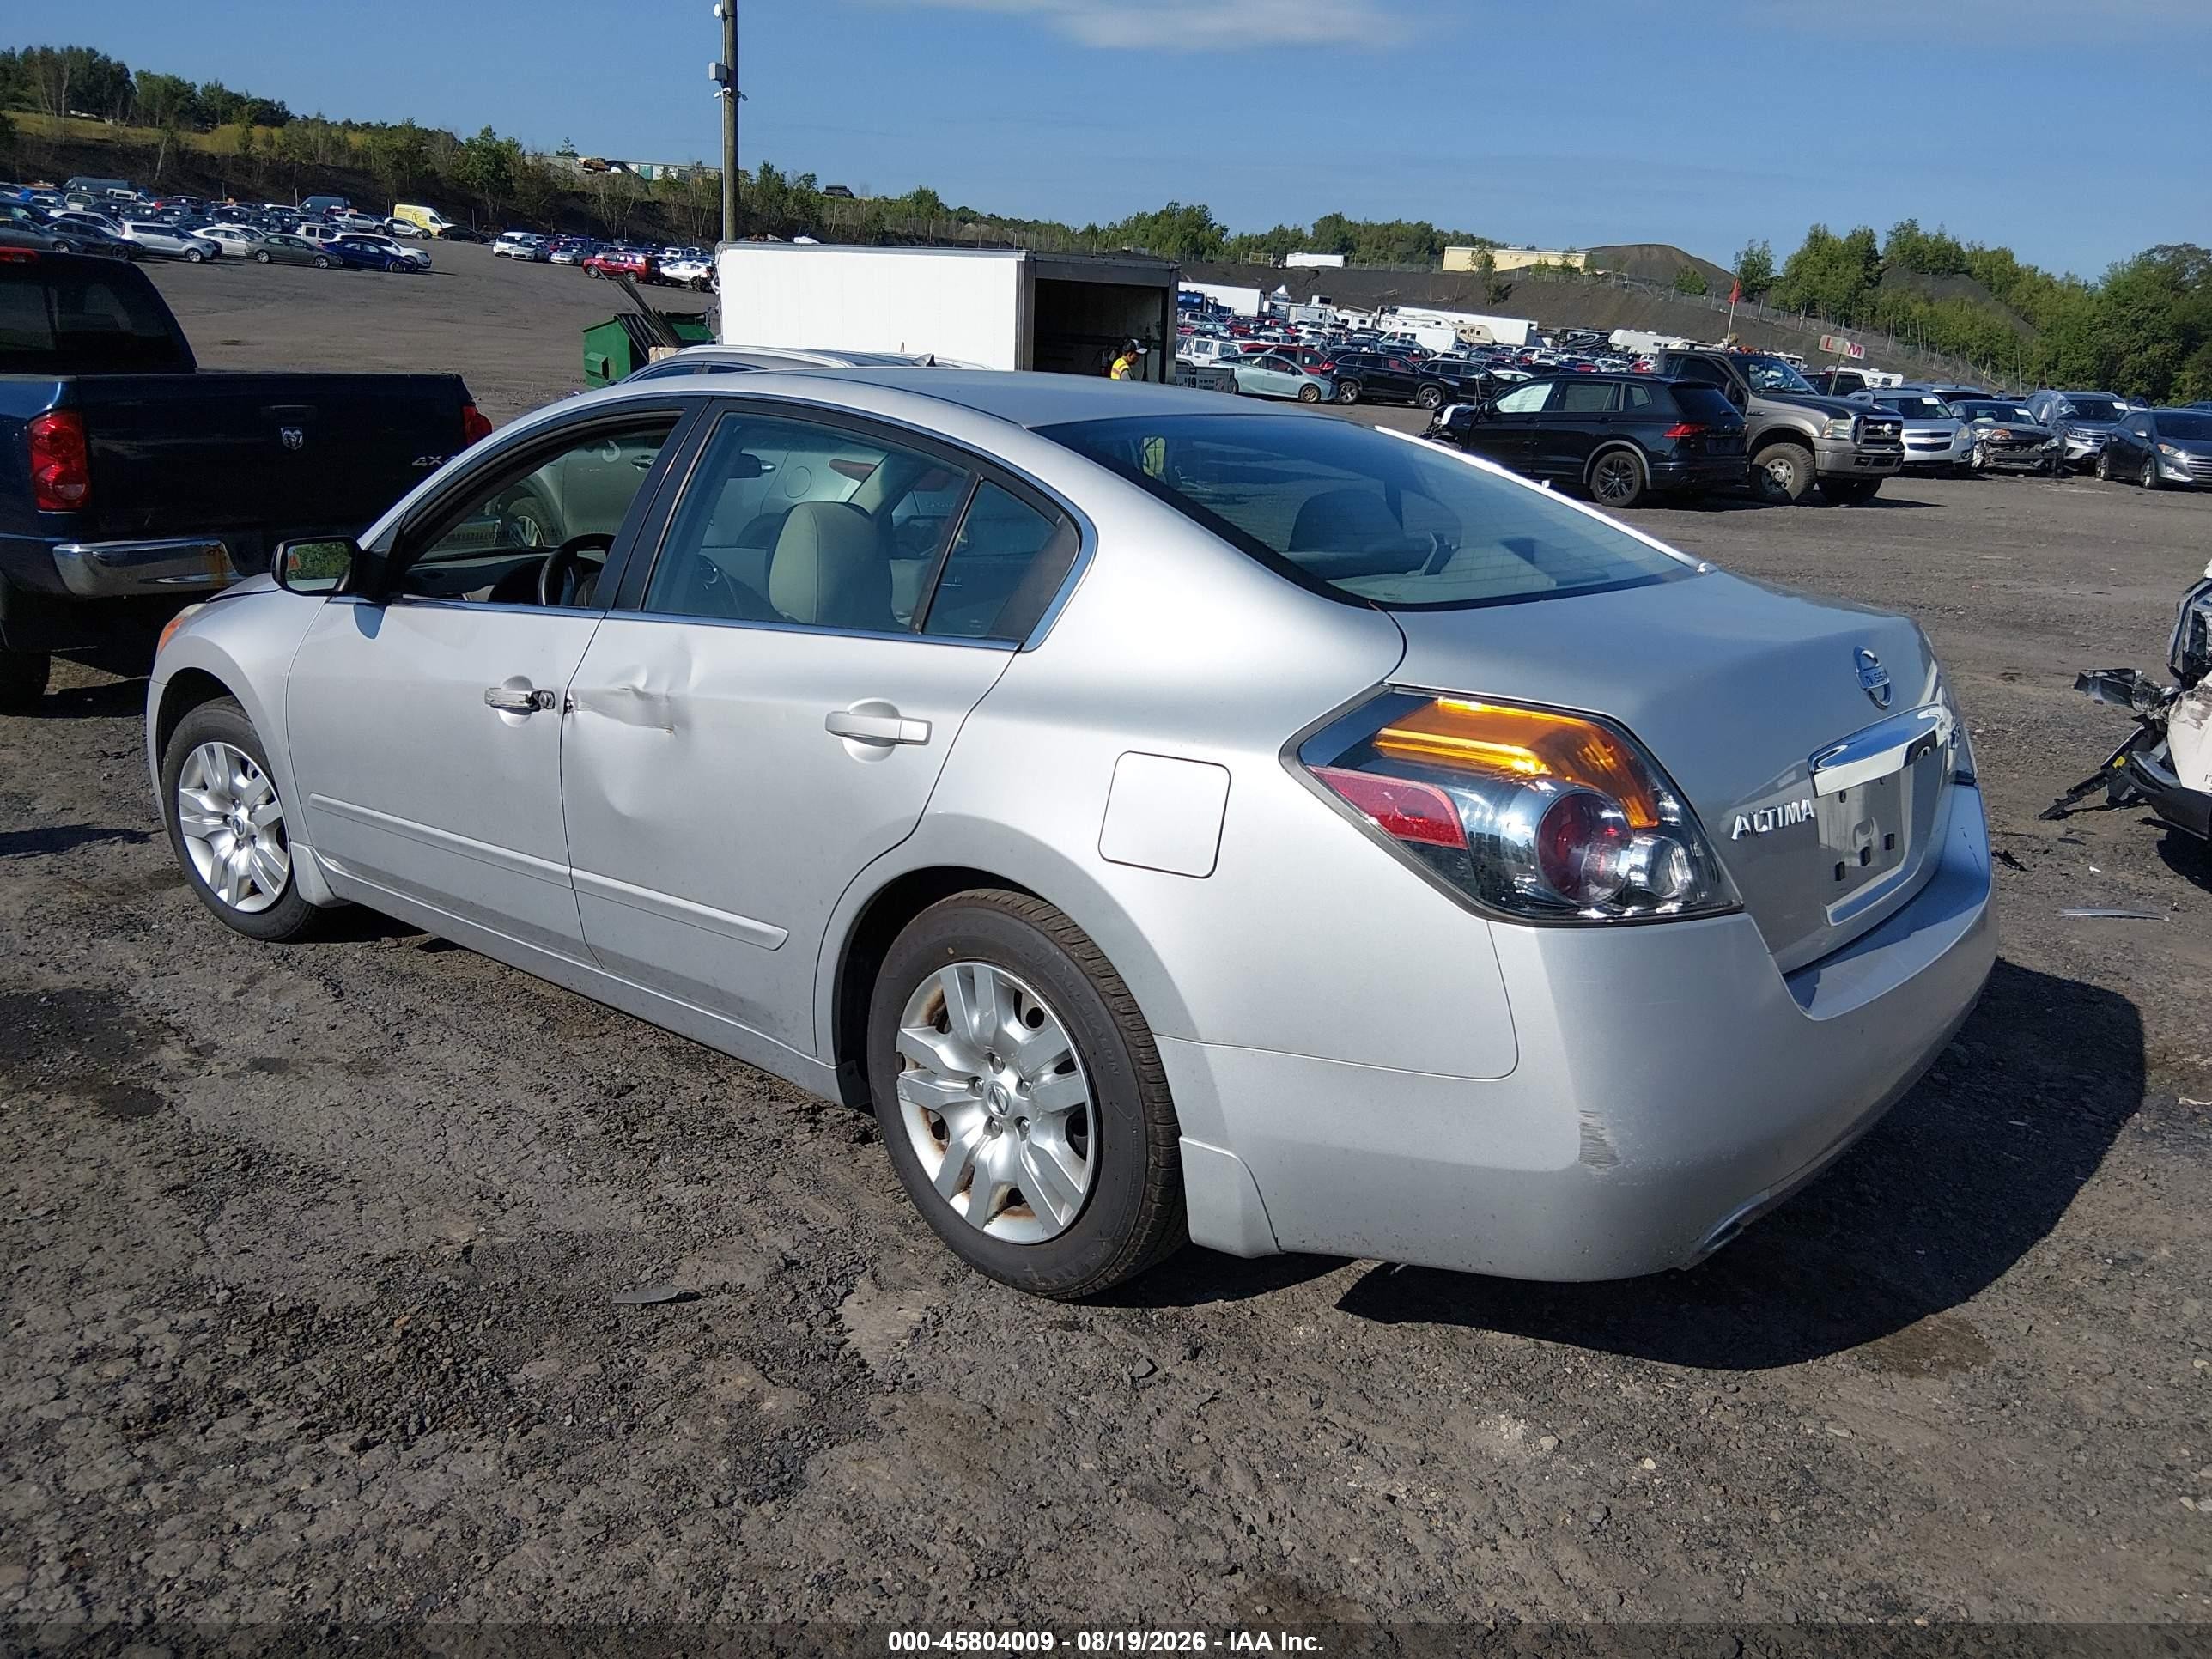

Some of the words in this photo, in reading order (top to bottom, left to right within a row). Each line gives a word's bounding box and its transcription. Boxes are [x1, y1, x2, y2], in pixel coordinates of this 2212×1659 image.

[1825, 337, 1833, 350] L
[1847, 343, 1863, 357] M
[1730, 798, 1815, 841] ALTIMA
